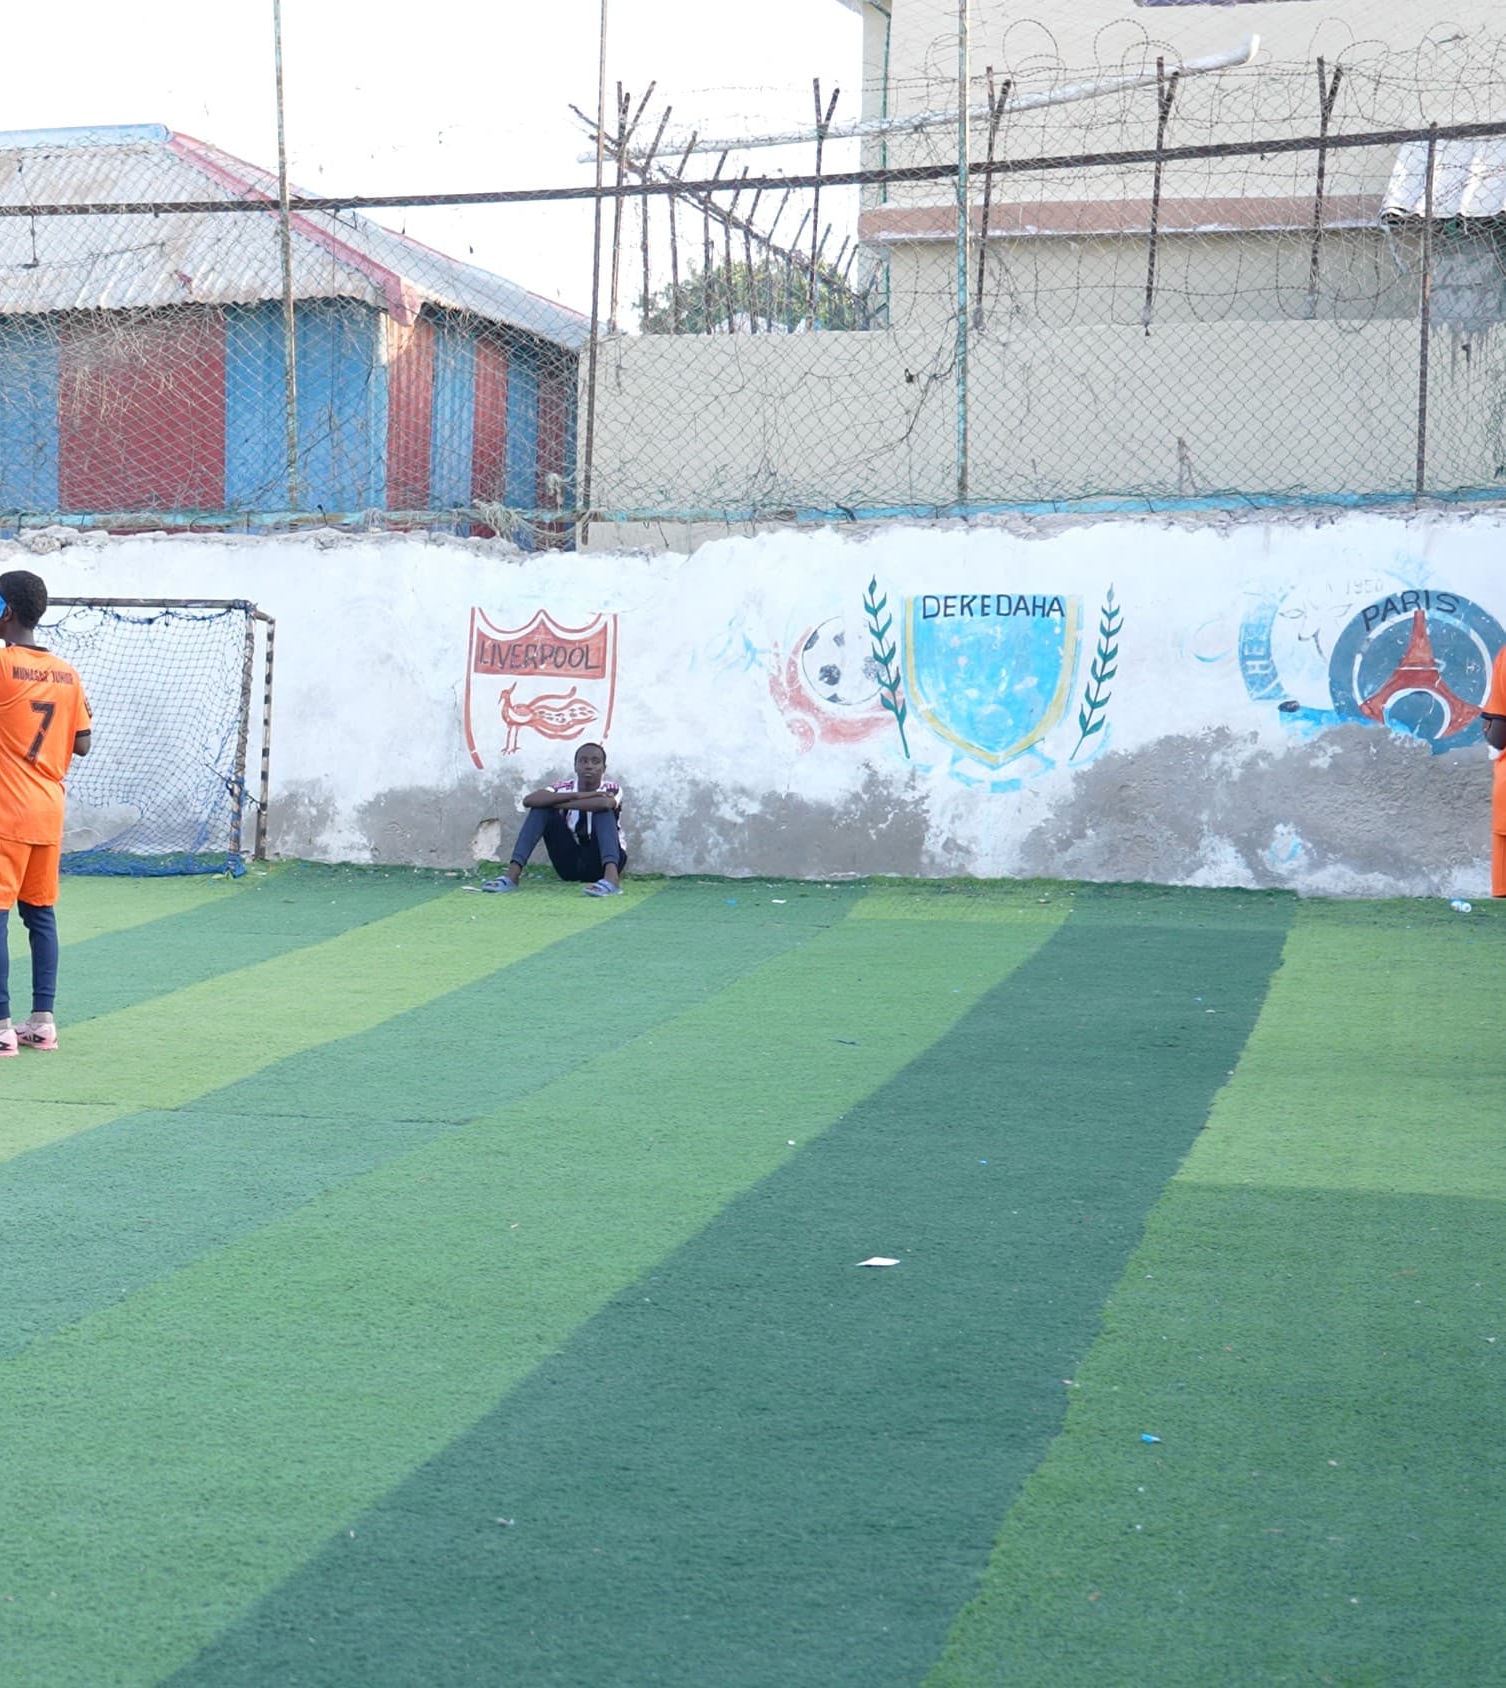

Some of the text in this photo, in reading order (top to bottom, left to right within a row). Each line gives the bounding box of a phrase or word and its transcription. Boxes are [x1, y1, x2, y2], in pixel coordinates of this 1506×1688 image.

[922, 593, 1066, 619] DEKEDAHA
[1361, 590, 1461, 632] PARIS
[479, 640, 601, 670] LIVERPOOL
[24, 700, 56, 765] 7
